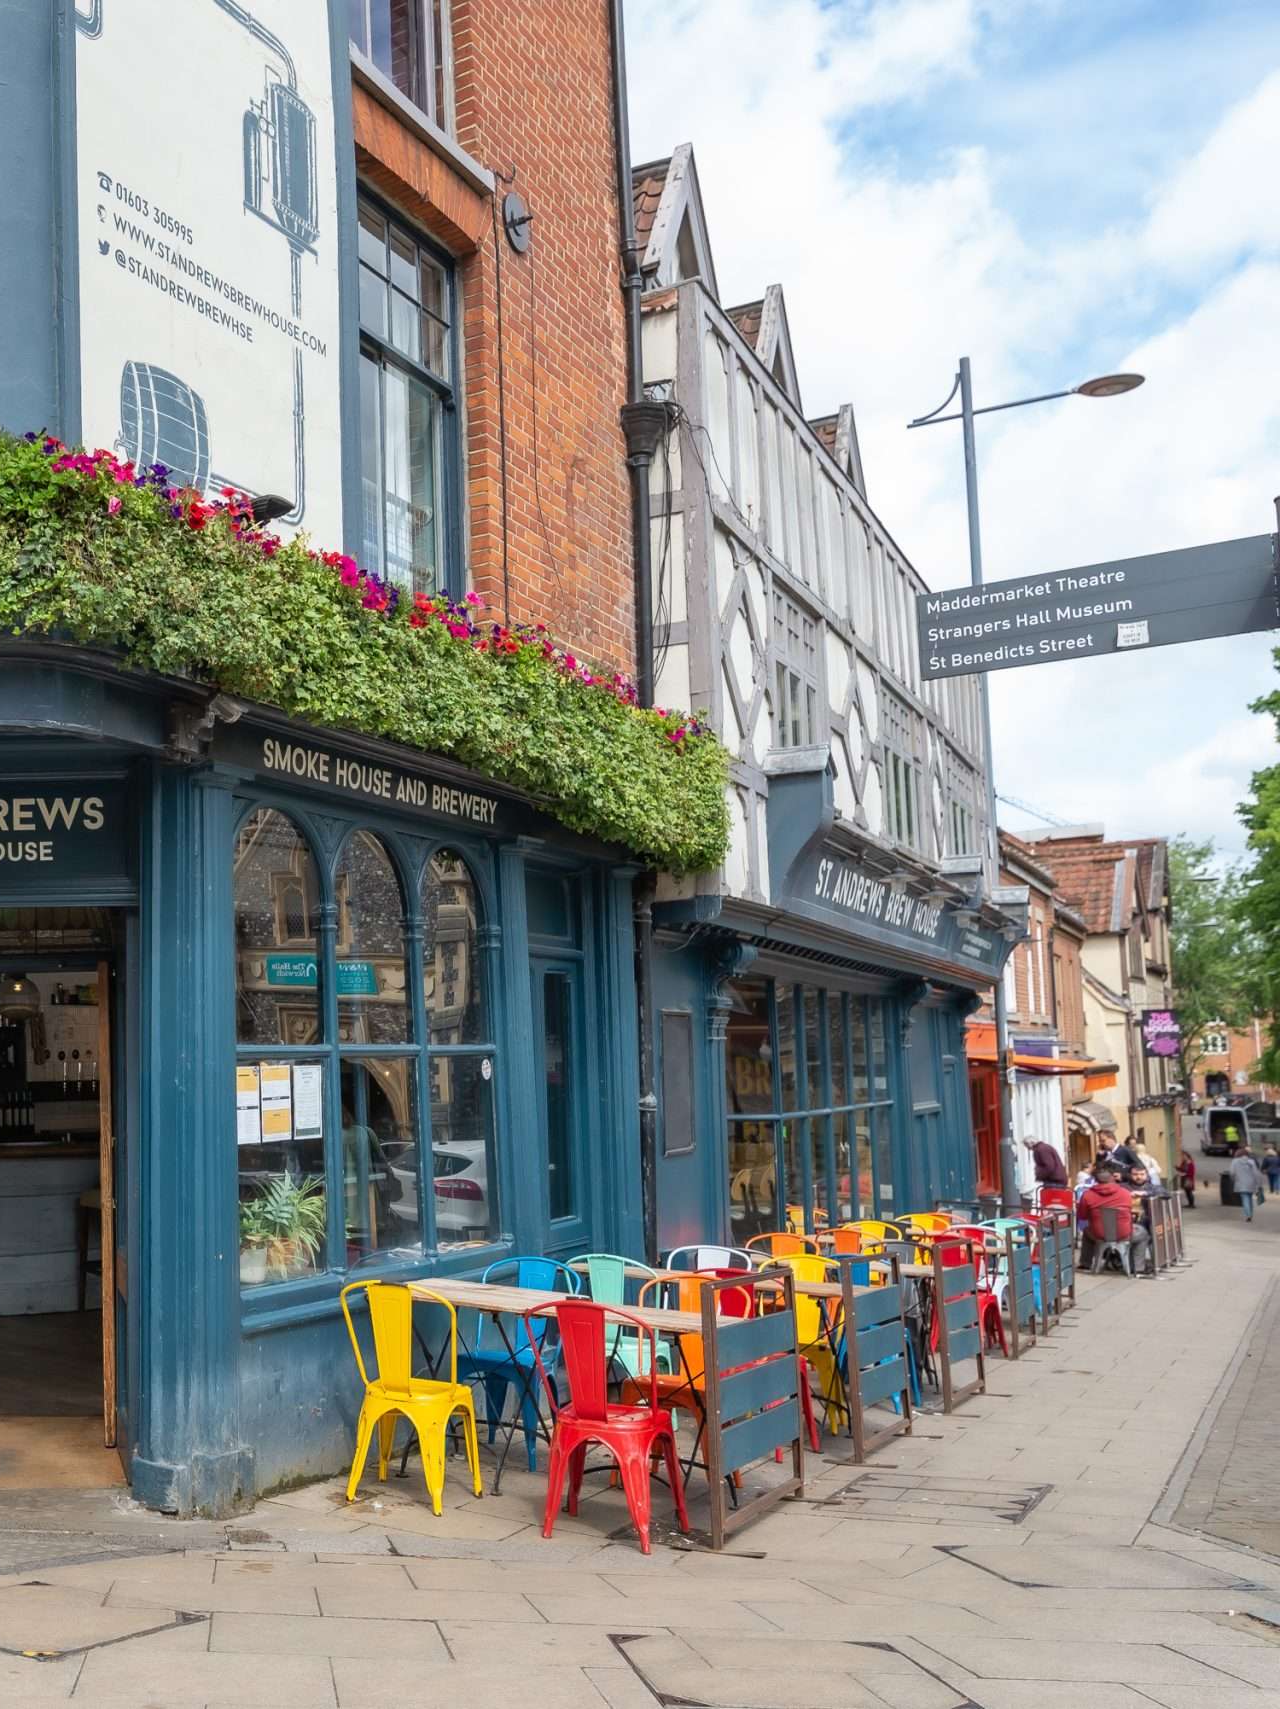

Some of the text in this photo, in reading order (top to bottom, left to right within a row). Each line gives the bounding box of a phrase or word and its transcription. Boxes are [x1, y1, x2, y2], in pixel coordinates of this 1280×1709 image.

[115, 182, 194, 246] 01603 305995
[113, 211, 327, 357] WWW.STANDREWSBREWHOUSE.COM
[115, 248, 254, 344] @STANDREWBREWHSE
[927, 568, 1126, 615] Maddermarket Theatre
[928, 598, 1133, 643] Strangers Hall Museum
[929, 656, 947, 670] St
[952, 642, 1035, 668] Benedicts
[1039, 633, 1094, 654] Street
[263, 738, 498, 825] SMOKE HOUSE AND BREWERY
[815, 857, 941, 938] ST. ANDREWS BREW HOUSE
